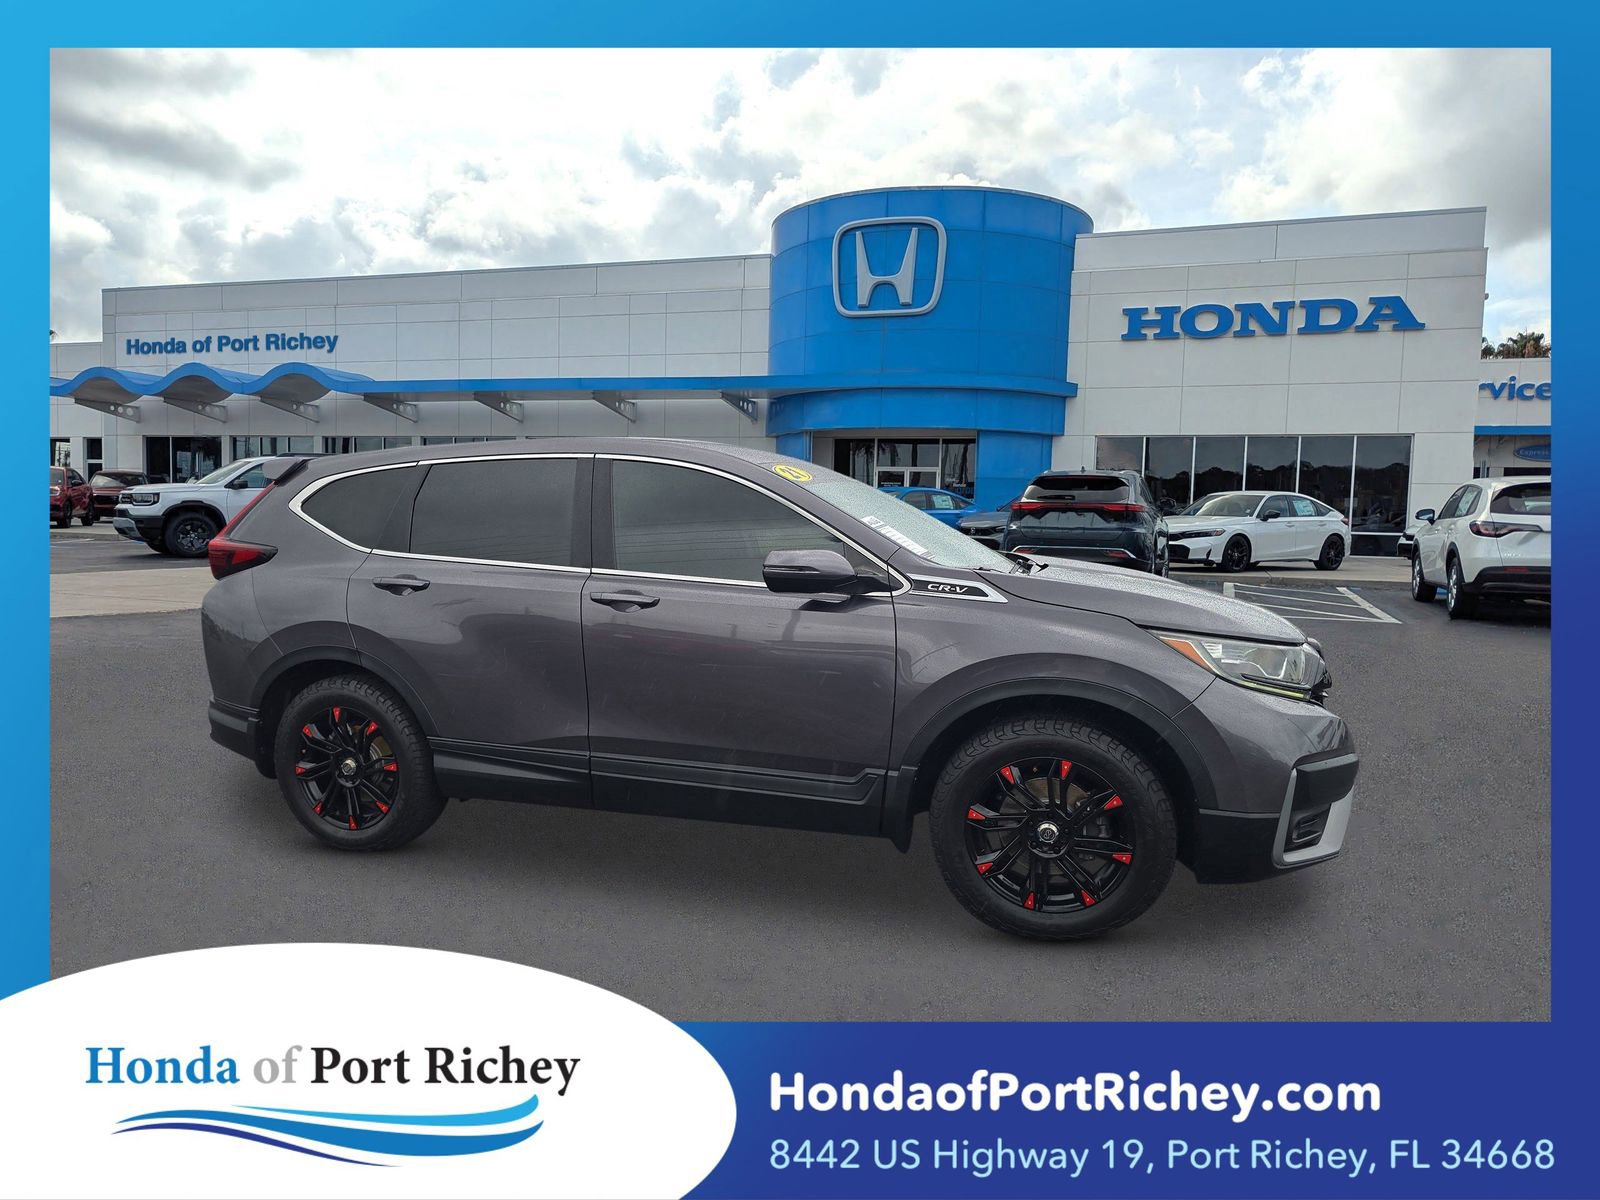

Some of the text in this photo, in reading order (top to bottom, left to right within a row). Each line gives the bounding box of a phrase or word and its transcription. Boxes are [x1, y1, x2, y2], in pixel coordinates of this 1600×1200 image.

[1121, 295, 1425, 341] HONDA
[126, 332, 338, 355] Honda of Port Richey
[927, 583, 969, 593] CR-V
